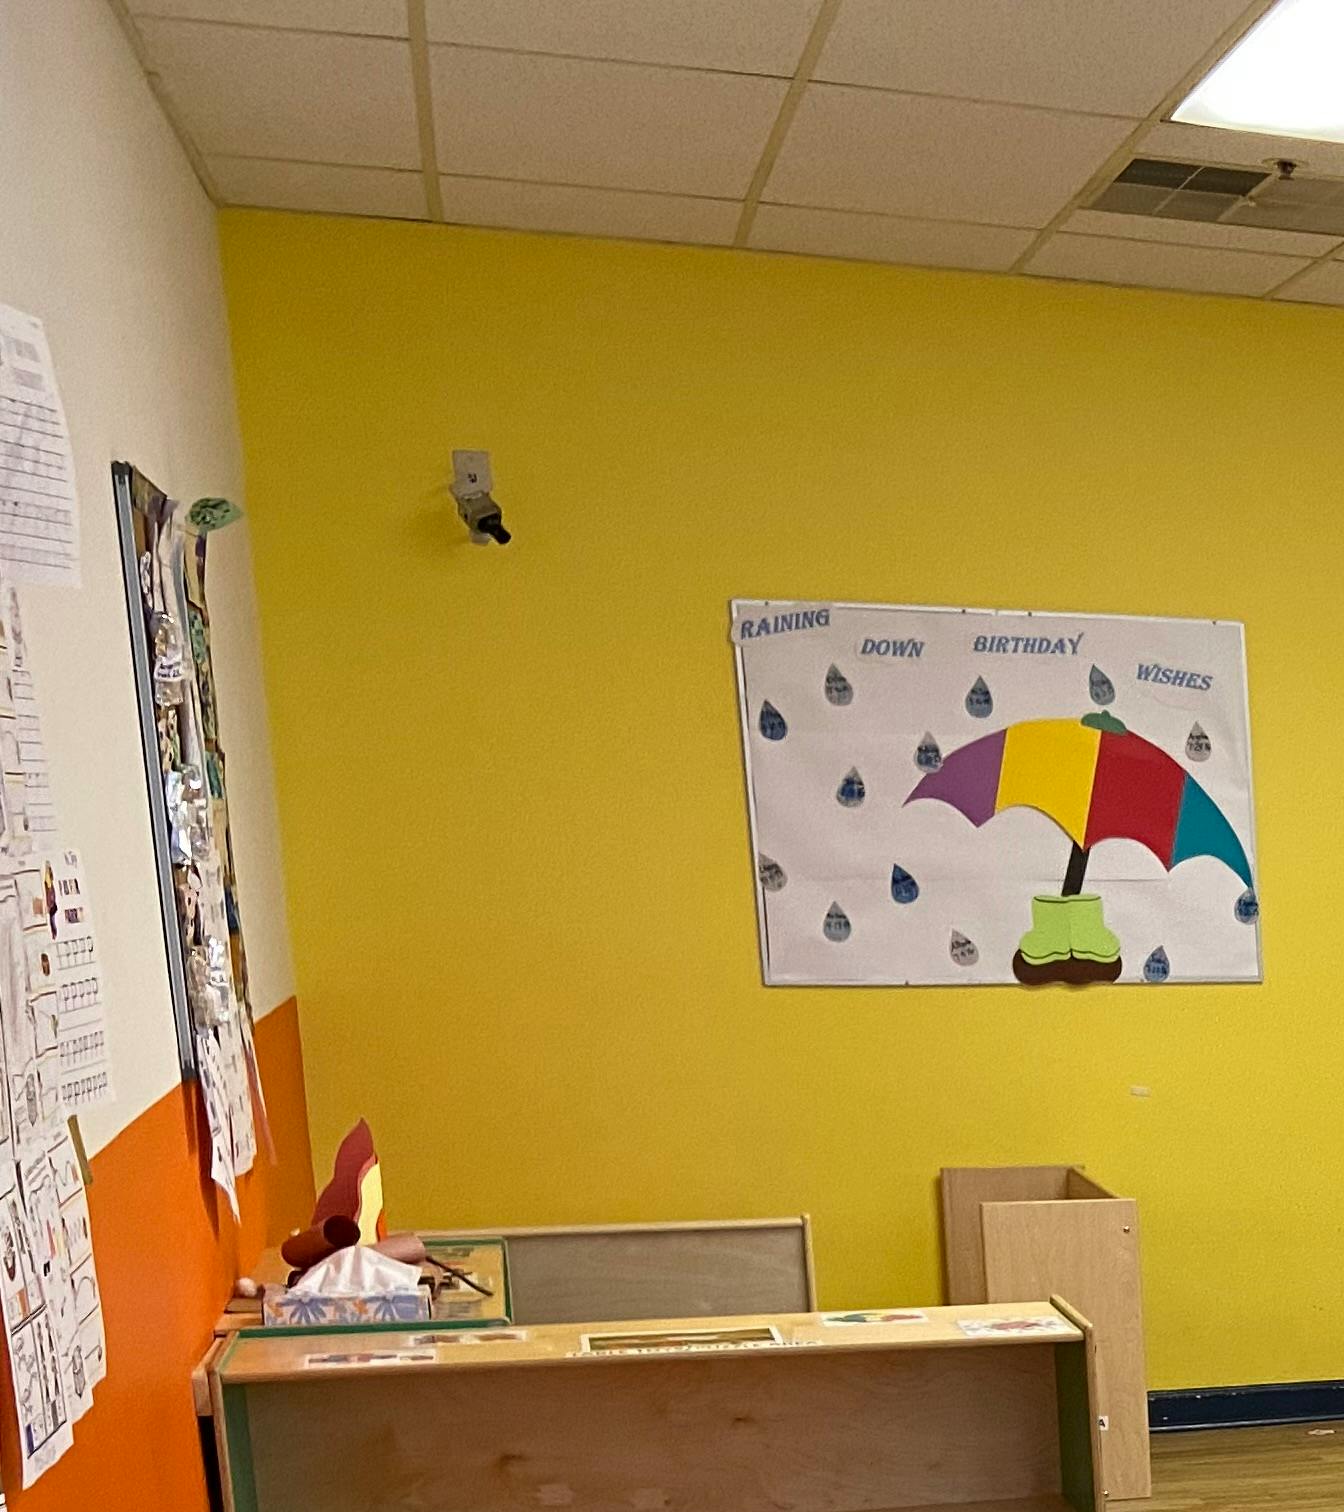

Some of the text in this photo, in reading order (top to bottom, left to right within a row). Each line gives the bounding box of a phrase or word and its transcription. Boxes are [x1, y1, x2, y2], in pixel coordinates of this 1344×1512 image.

[740, 608, 830, 639] RAINING
[861, 637, 924, 658] DOWN
[973, 632, 1084, 656] BIRTHDAY
[1136, 663, 1213, 691] WISHES
